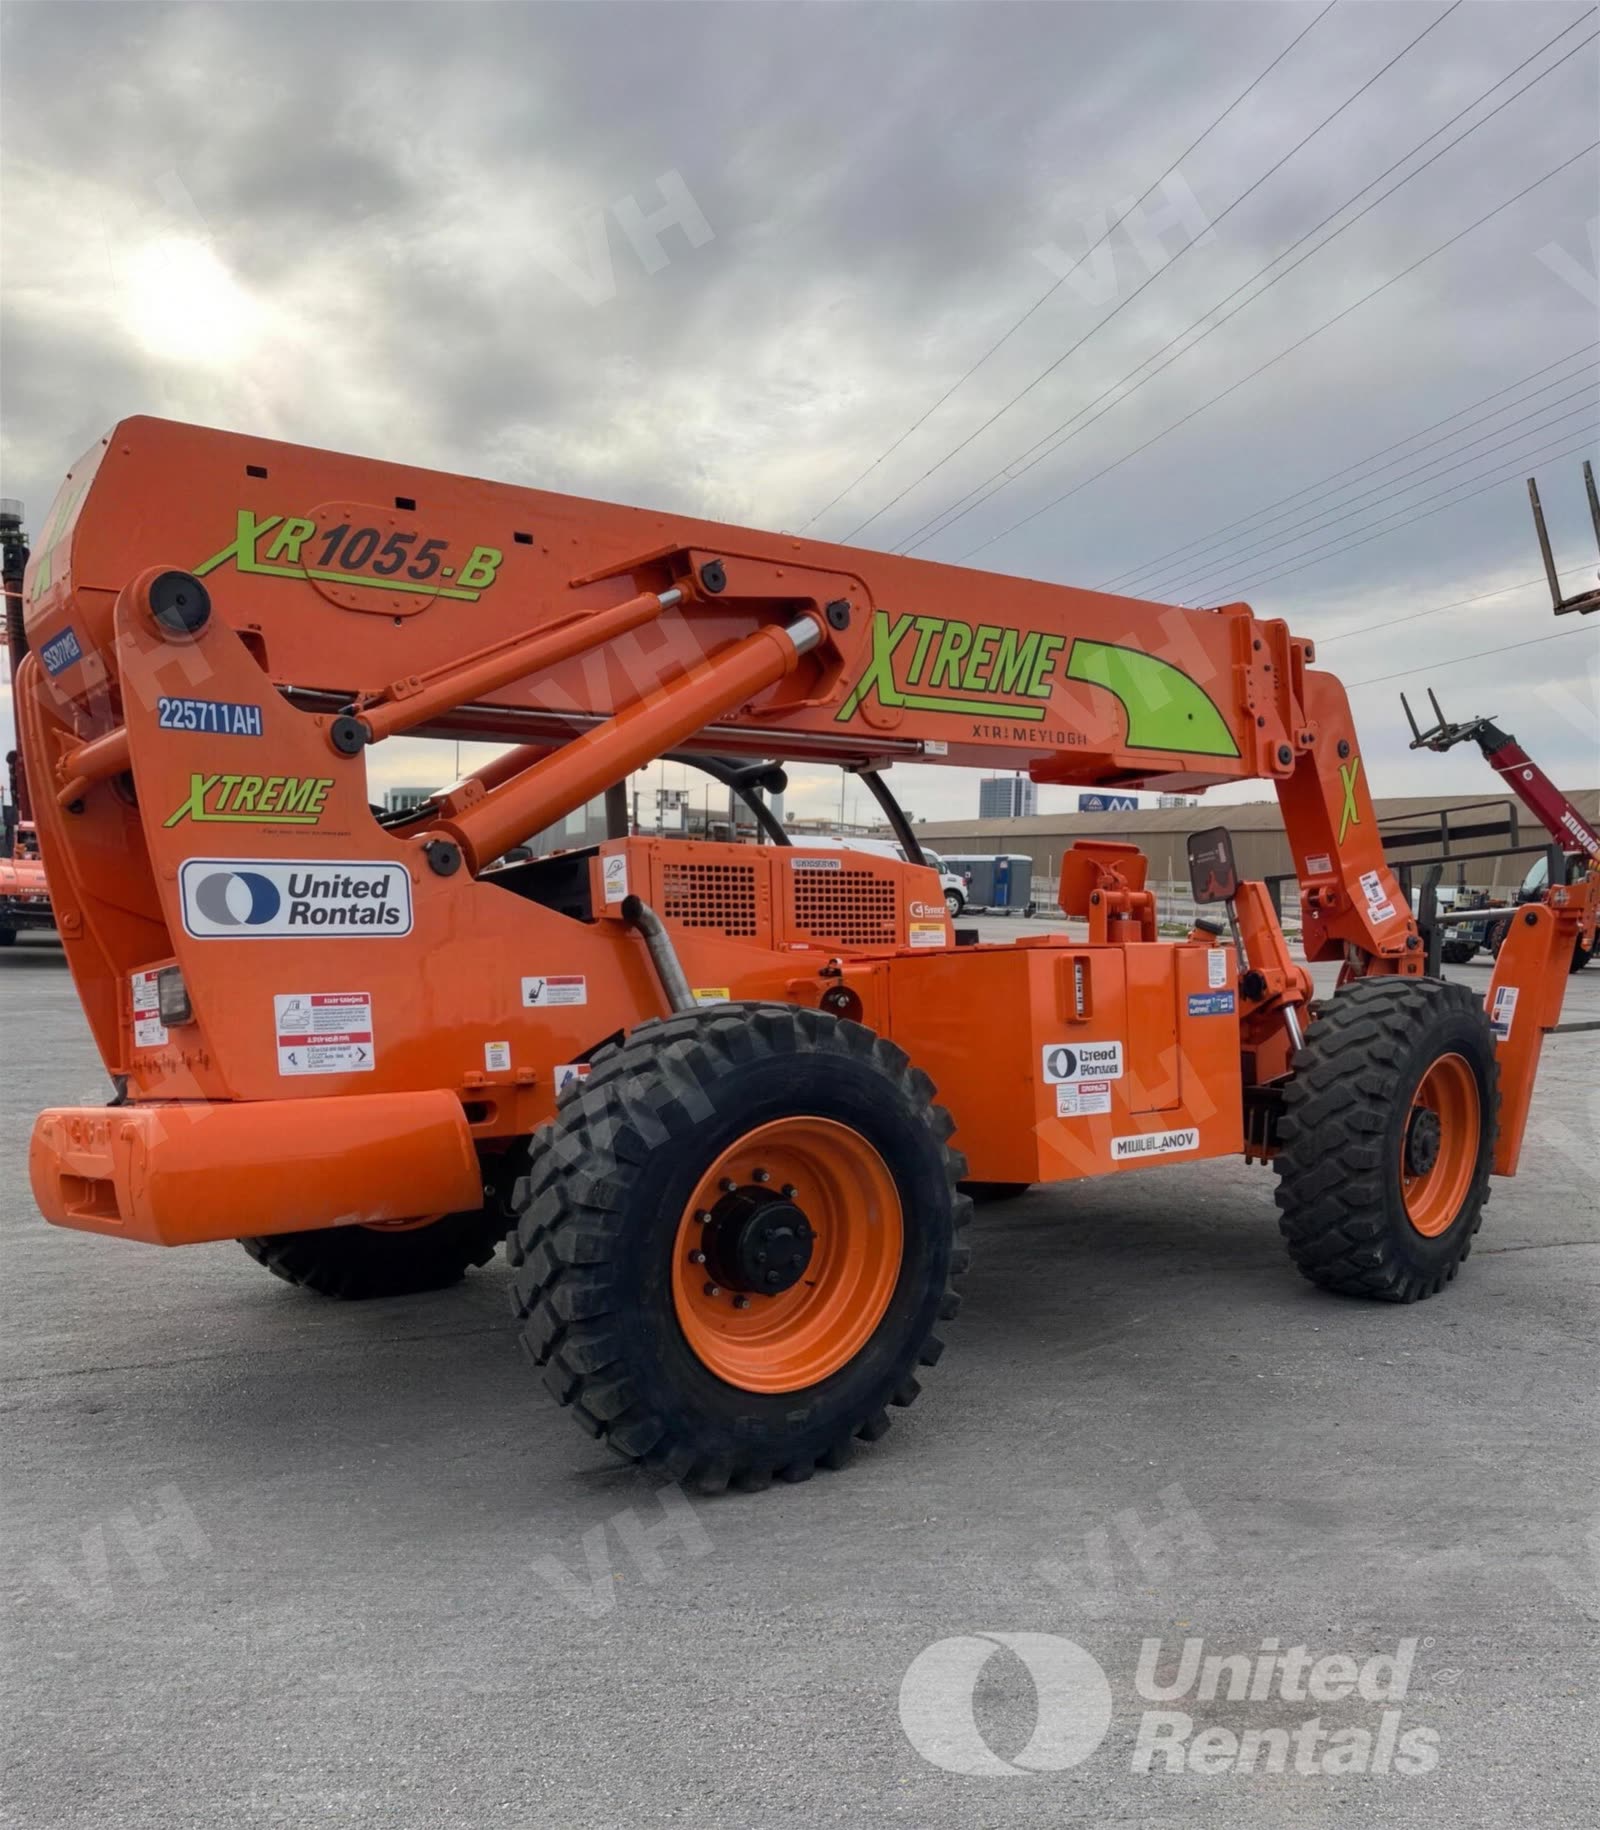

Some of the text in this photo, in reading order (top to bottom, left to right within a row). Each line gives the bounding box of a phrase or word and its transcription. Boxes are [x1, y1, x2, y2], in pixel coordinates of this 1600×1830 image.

[834, 610, 1066, 721] XTREME
[158, 697, 262, 736] 225711AH
[161, 773, 336, 828] XTREME
[288, 873, 391, 899] United
